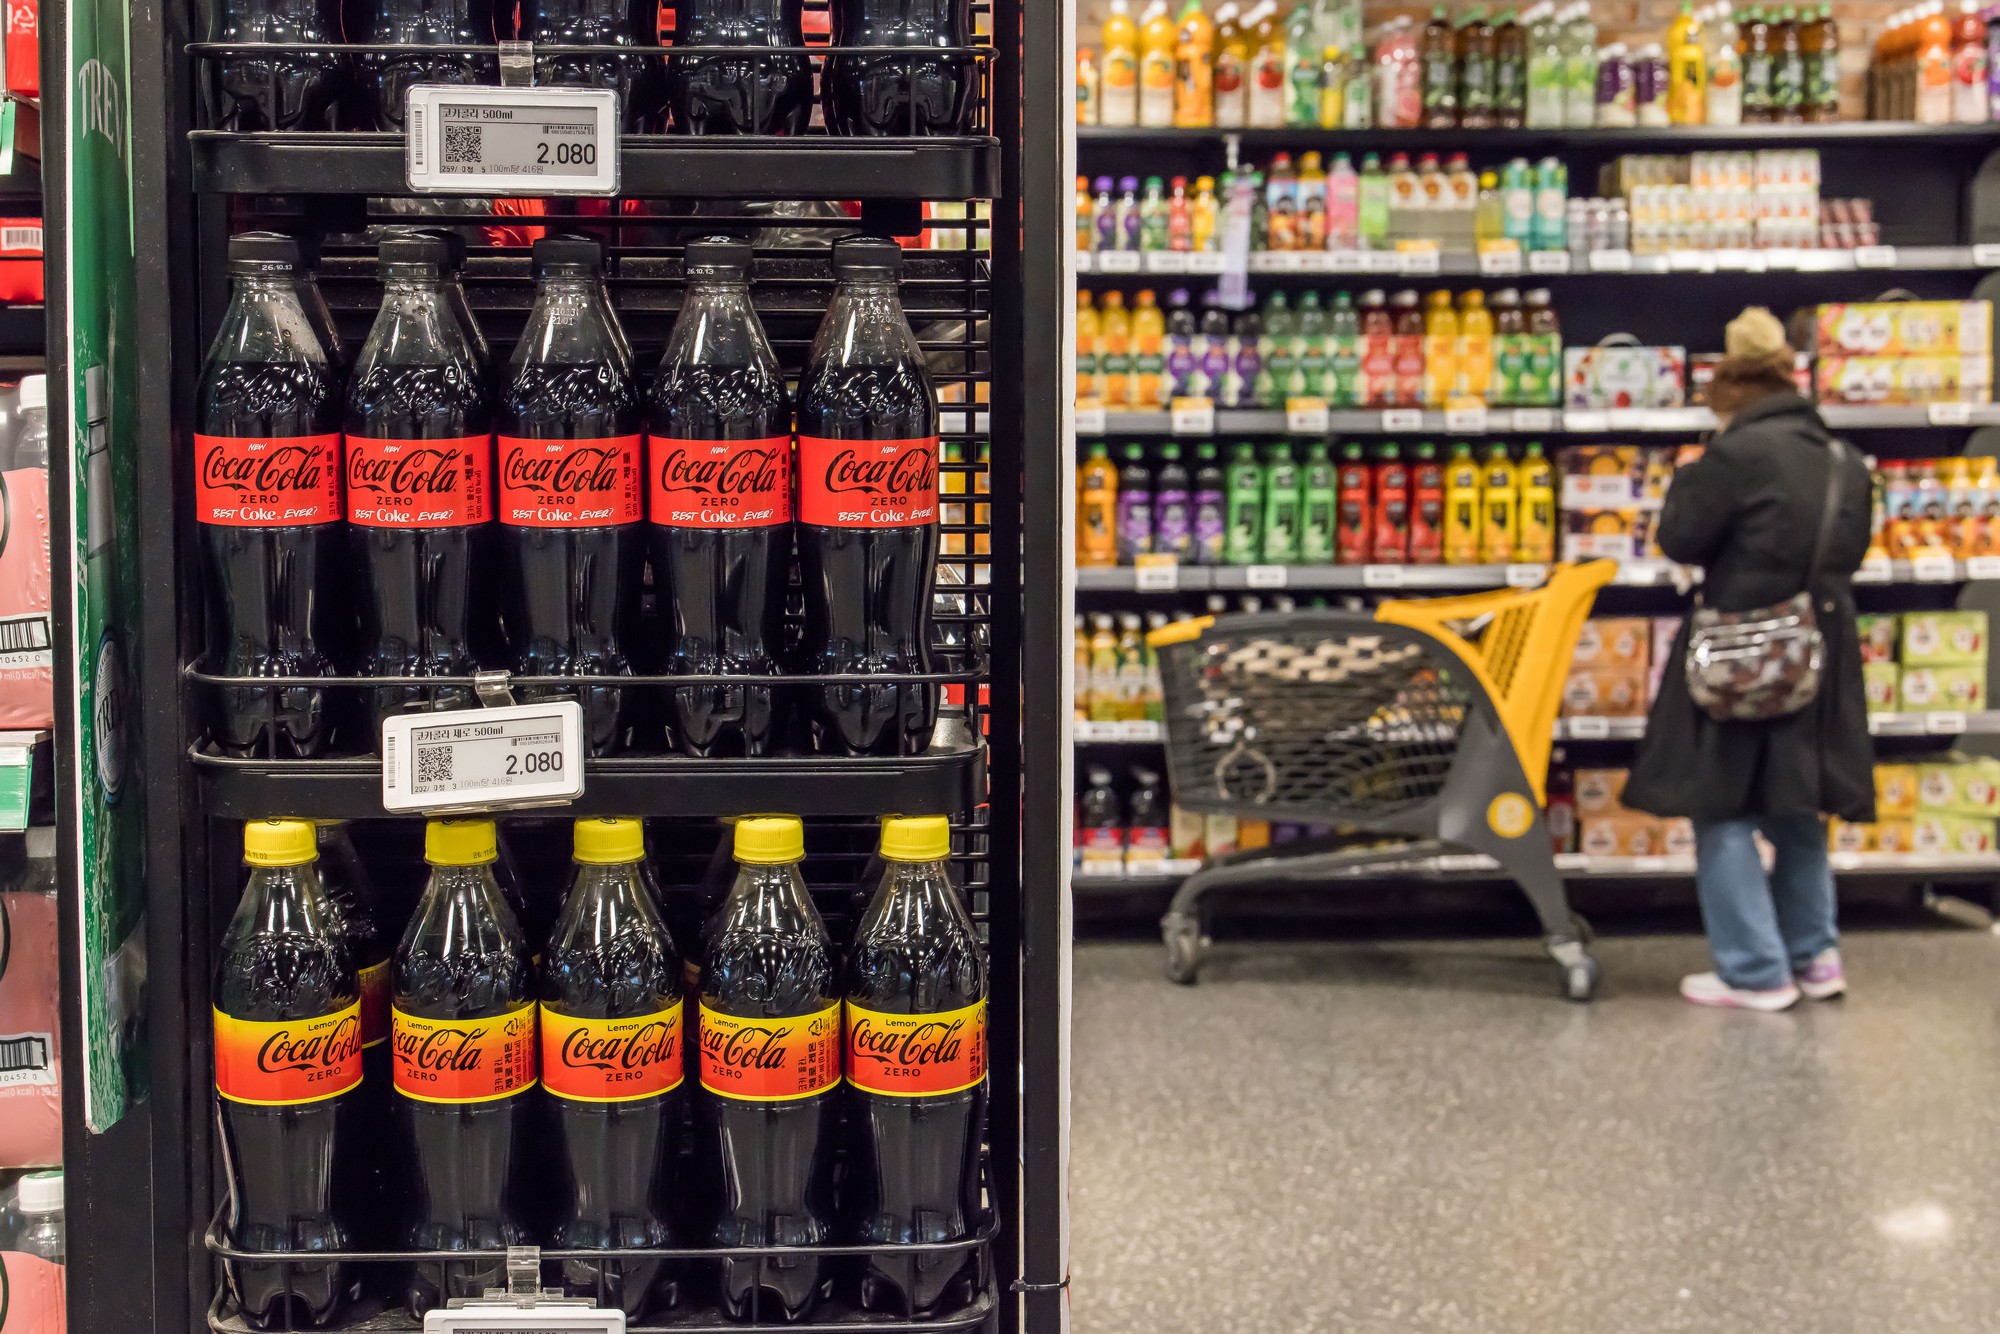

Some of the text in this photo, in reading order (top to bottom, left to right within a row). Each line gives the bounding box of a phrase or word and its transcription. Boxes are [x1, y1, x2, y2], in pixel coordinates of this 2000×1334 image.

[442, 108, 513, 120] 코카콜라 500ml
[537, 143, 596, 166] 2,080
[248, 443, 267, 452] NEW
[383, 444, 402, 454] NEW
[545, 444, 564, 453] NEW
[710, 445, 730, 455] NEW
[881, 445, 900, 455] NEW
[203, 445, 326, 492] Coca-Cola
[349, 447, 464, 493] Coca-Cola
[465, 453, 473, 481] 제로
[504, 446, 622, 492] Coca-Cola
[662, 448, 782, 494] Coca-Cola
[240, 495, 279, 504] ZERO
[376, 496, 413, 505] ZERO
[537, 496, 576, 505] ZERO
[701, 497, 739, 506] ZERO
[871, 496, 907, 506] ZERO
[213, 506, 318, 521] BEST Coke EVER?
[355, 508, 454, 523] BEST Coke EVER?
[512, 507, 614, 522] BEST Coke EVER?
[671, 509, 773, 523] BEST Coke EVER?
[838, 511, 868, 522] BEST
[870, 509, 905, 523] Coke
[416, 726, 504, 741] 코카콜라 제로 500ml
[506, 751, 563, 776] 2,080
[308, 1019, 338, 1031] Lemon
[407, 1020, 433, 1032] Lemon
[607, 1022, 640, 1032] Lemon
[714, 1016, 739, 1029] Lemon
[886, 1018, 917, 1028] Lemon
[561, 1014, 679, 1070] Coca-Cola
[852, 1017, 967, 1065] Coca-Cola
[504, 1042, 513, 1089] 제로 레몬
[712, 1064, 742, 1079] ZERO
[808, 1042, 816, 1088] 제로 레몬
[307, 1066, 341, 1082] ZERO
[407, 1069, 437, 1082] ZERO
[605, 1070, 644, 1083] ZERO
[884, 1066, 921, 1078] ZERO
